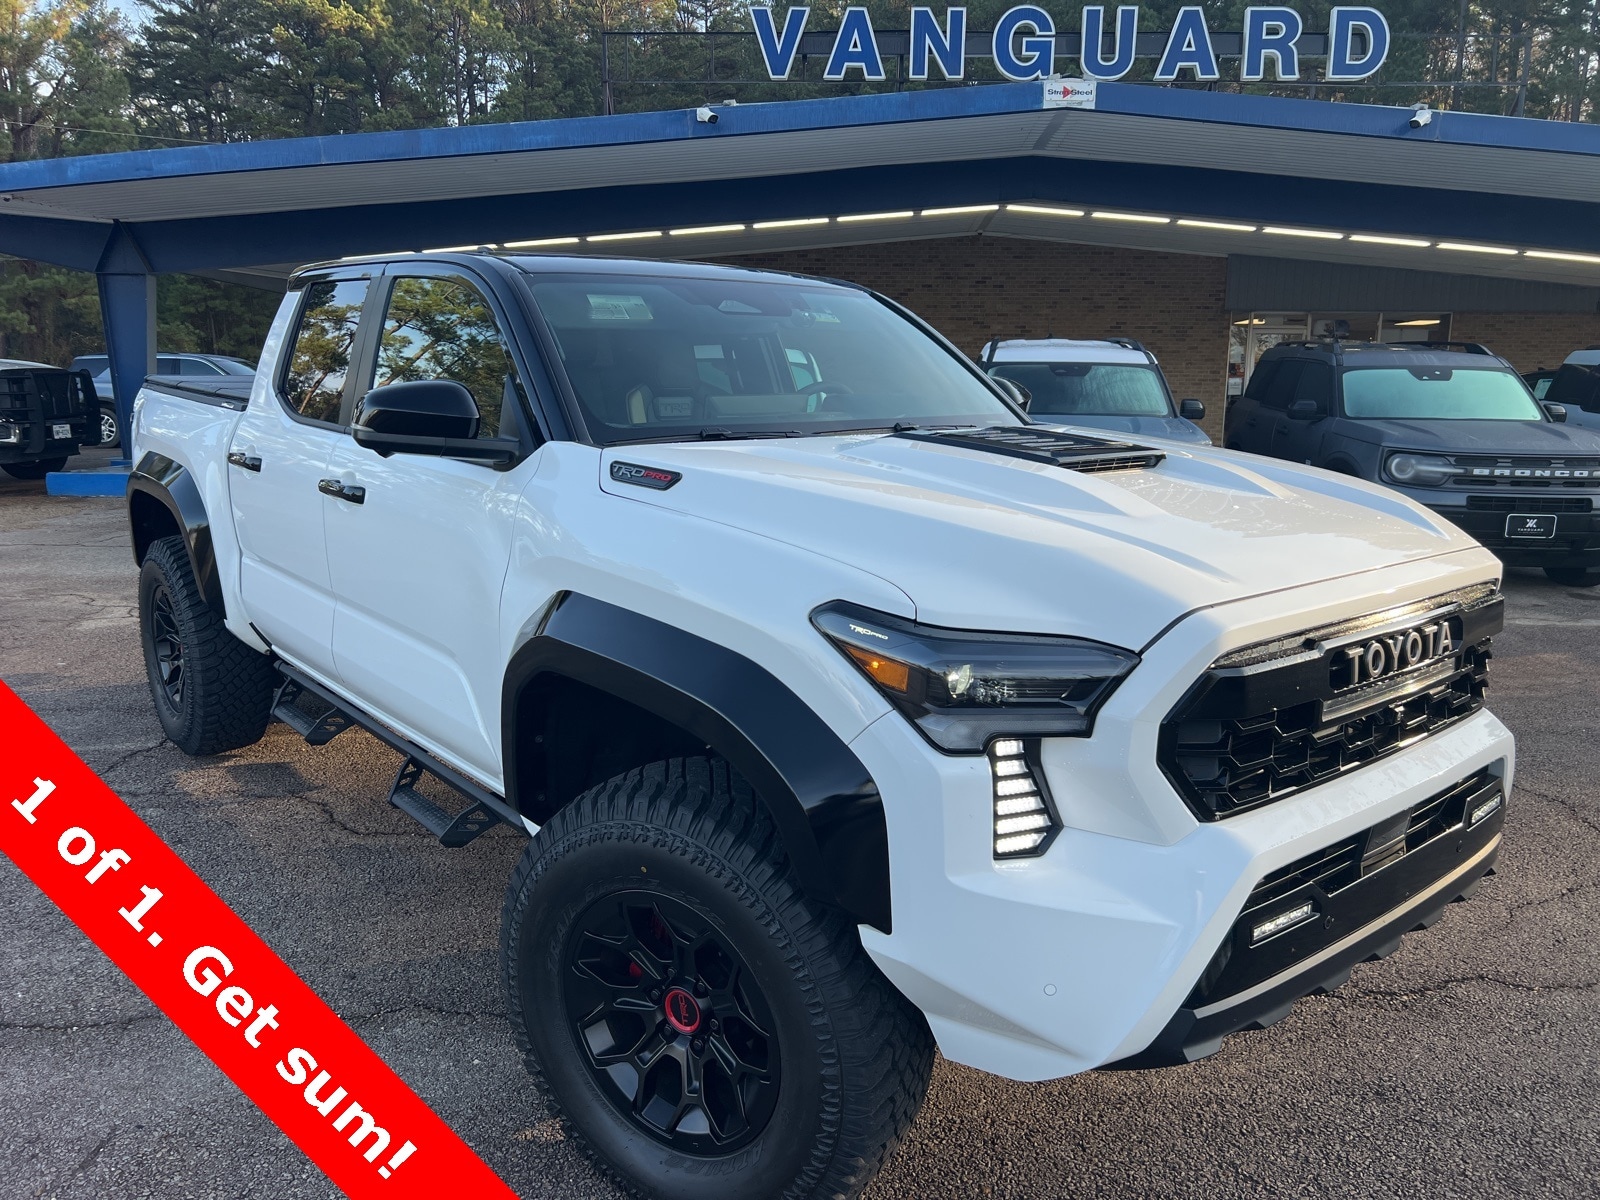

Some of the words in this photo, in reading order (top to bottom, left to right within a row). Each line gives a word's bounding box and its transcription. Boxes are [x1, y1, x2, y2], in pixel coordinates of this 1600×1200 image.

[748, 5, 1391, 82] VANGUARD
[1472, 468, 1589, 477] BRONCO
[1345, 621, 1453, 684] TOYOTA
